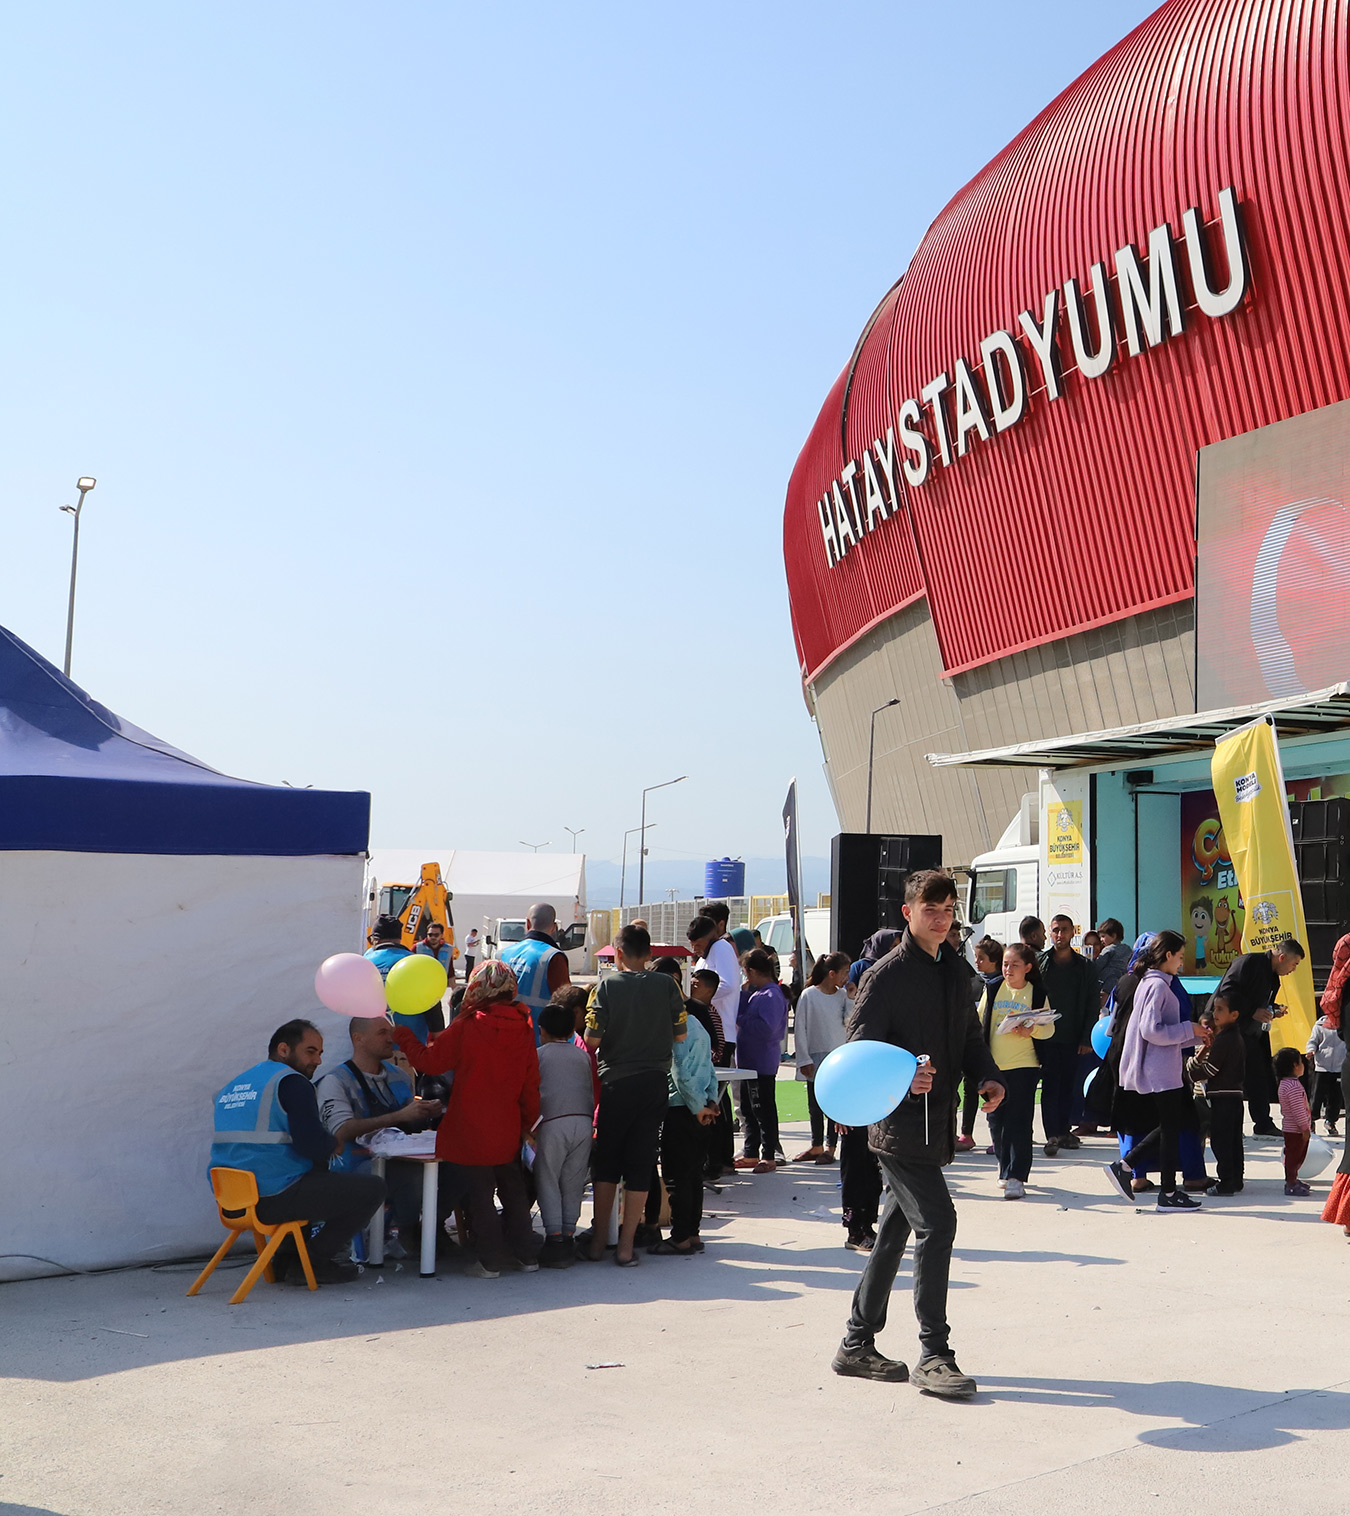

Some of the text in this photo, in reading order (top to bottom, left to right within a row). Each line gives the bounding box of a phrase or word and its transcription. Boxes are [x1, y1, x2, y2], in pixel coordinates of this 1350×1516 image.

[817, 185, 1250, 569] HATAY STADYUMU
[1235, 772, 1256, 787] KONYA
[1057, 834, 1072, 843] KONYA
[405, 904, 421, 934] JCB
[1258, 926, 1279, 935] KONYA
[232, 1083, 251, 1092] KONYA
